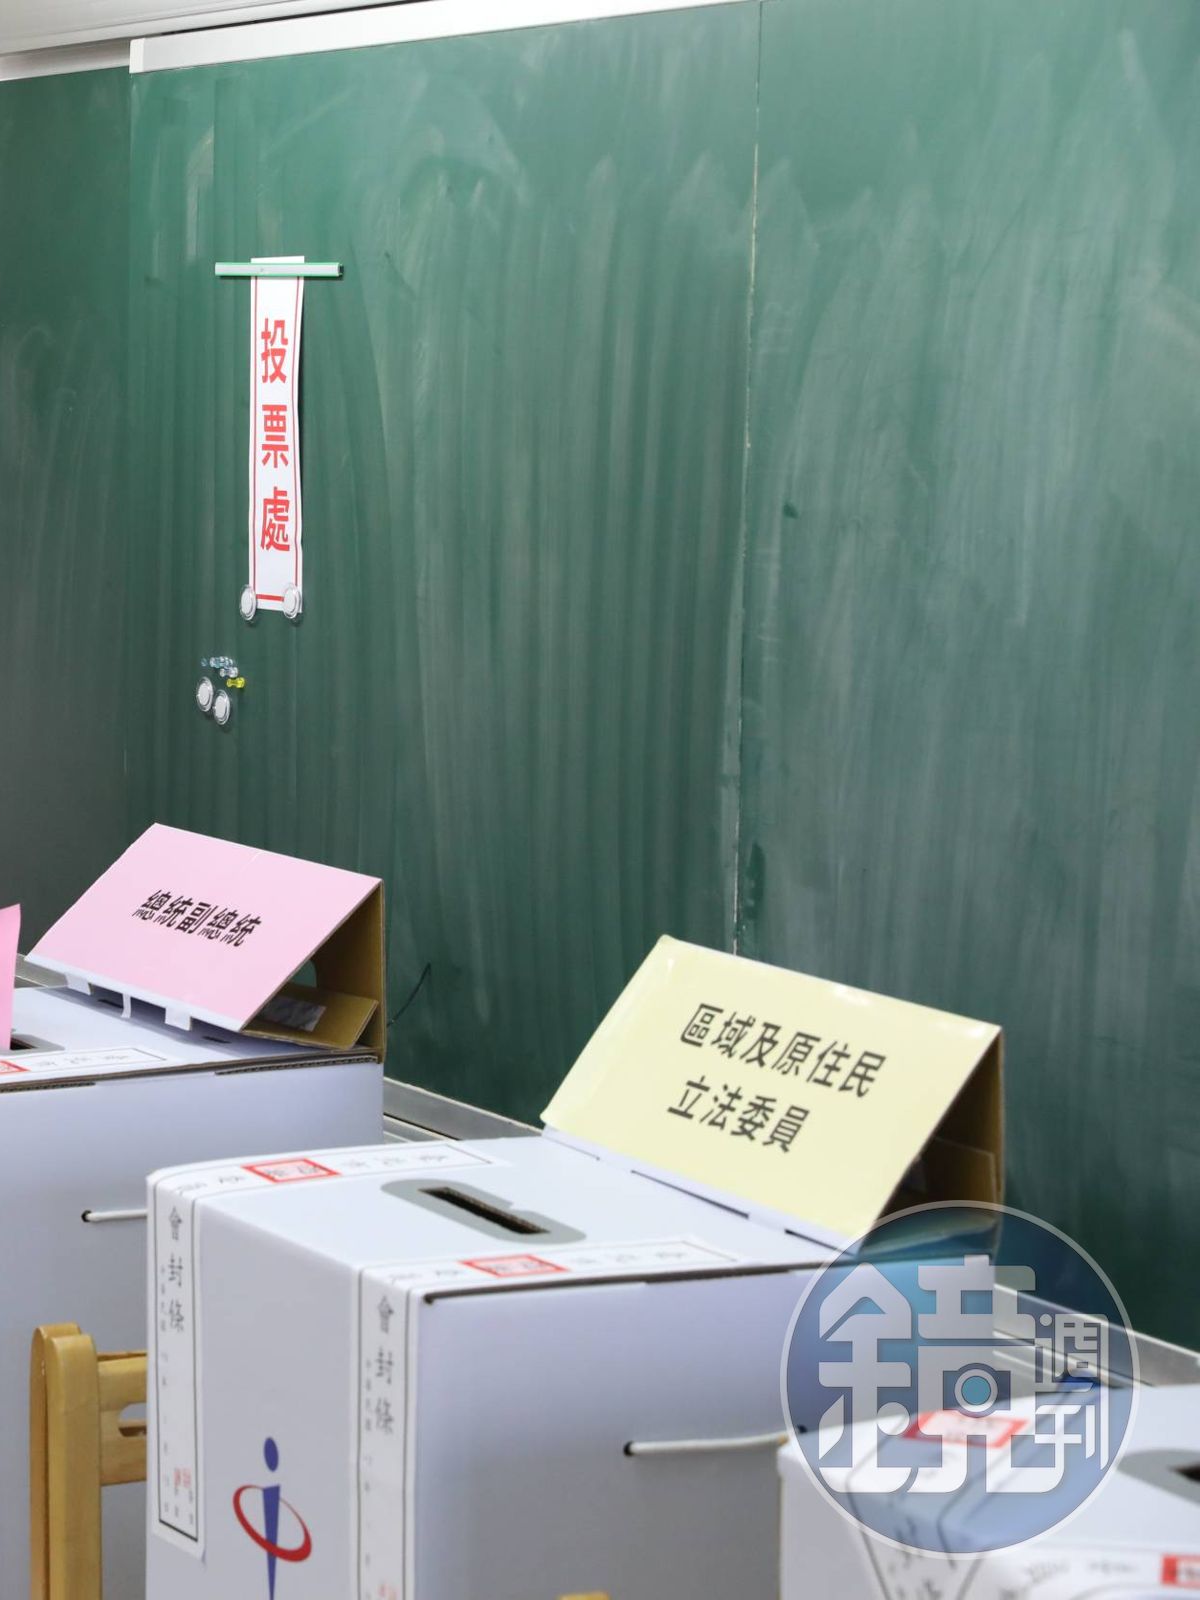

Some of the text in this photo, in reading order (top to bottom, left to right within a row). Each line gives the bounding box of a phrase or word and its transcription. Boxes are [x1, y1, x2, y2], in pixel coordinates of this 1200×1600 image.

[261, 318, 291, 553] 投票處
[132, 889, 262, 948] 總統副總統
[680, 1002, 887, 1099] 區域及原住民
[667, 1075, 810, 1153] 立法委員
